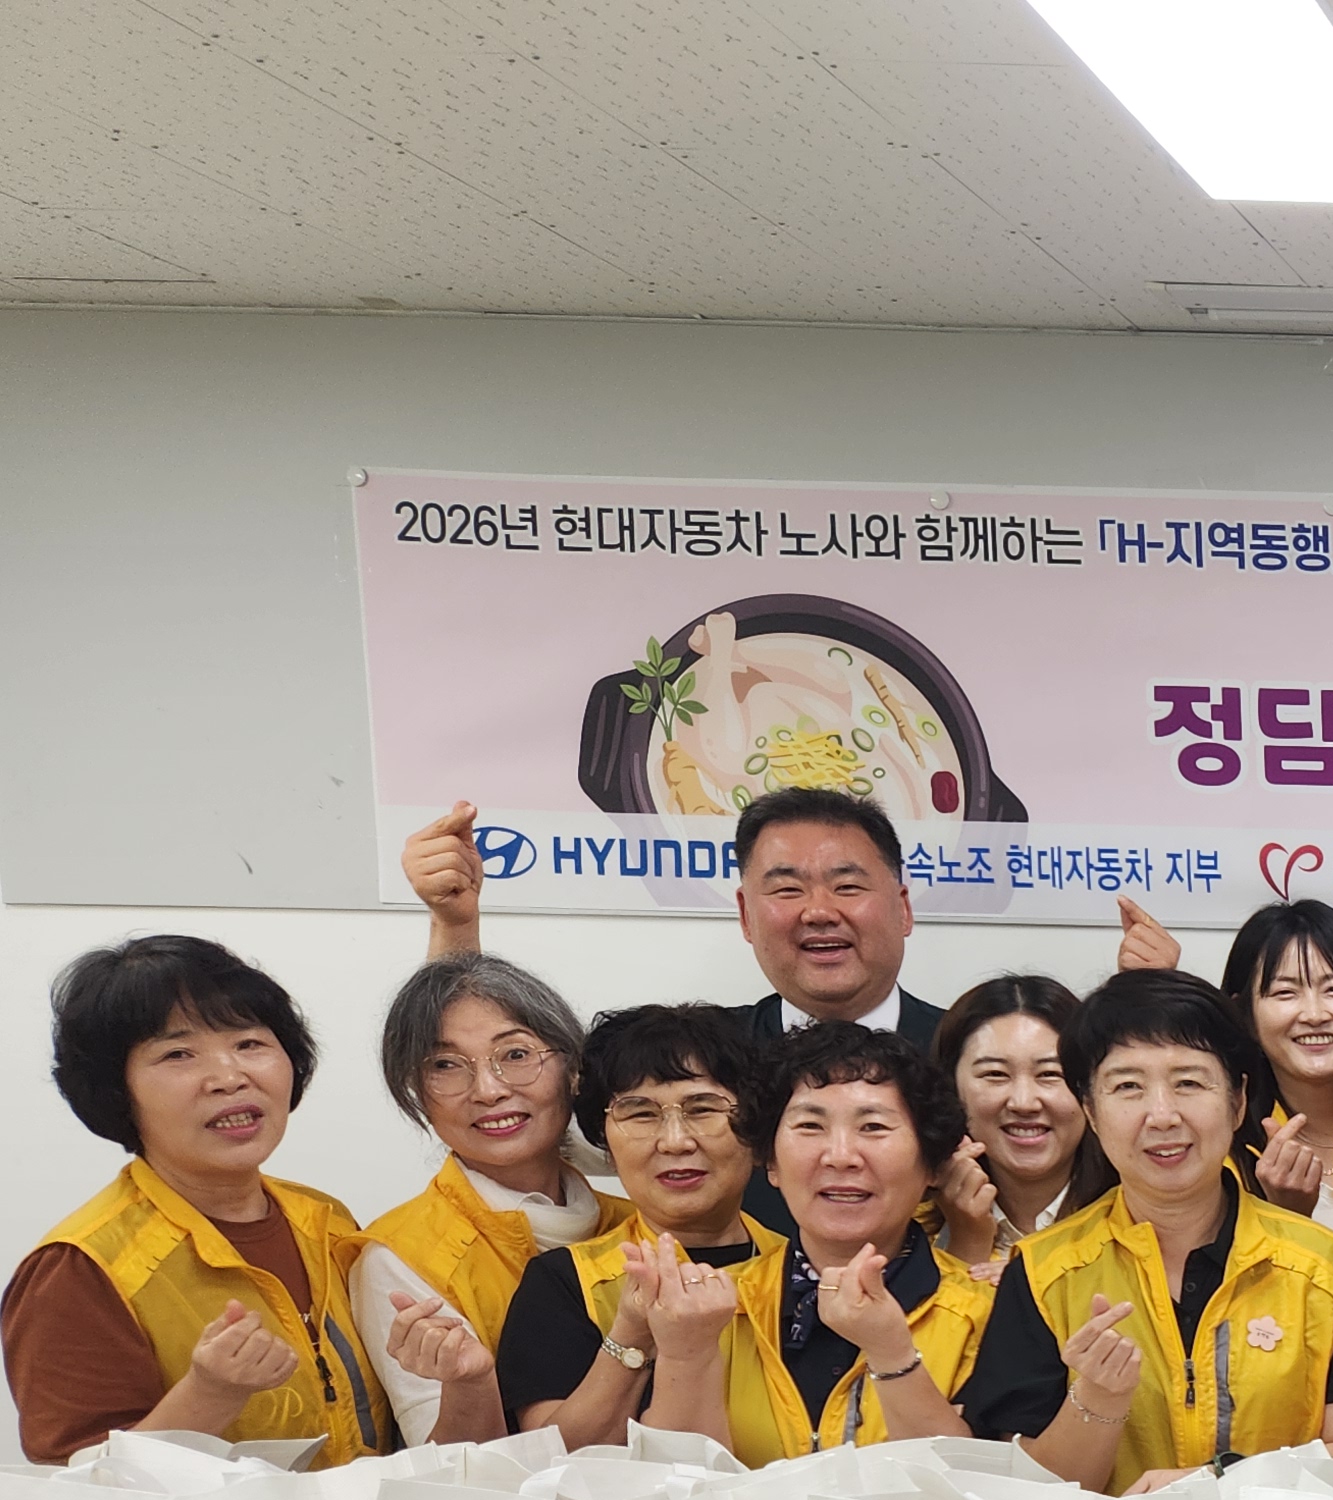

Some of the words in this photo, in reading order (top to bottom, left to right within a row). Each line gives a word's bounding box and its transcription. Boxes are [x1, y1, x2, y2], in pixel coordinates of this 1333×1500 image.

[395, 501, 541, 553] 2026년
[552, 504, 769, 559] 현대자동차
[779, 512, 908, 562] 노사와
[915, 514, 1084, 567] 함께하는
[553, 836, 738, 879] HYUNDA
[900, 841, 995, 886] 속노조
[1006, 845, 1153, 892] 현대자동차
[1165, 849, 1222, 893] 지부
